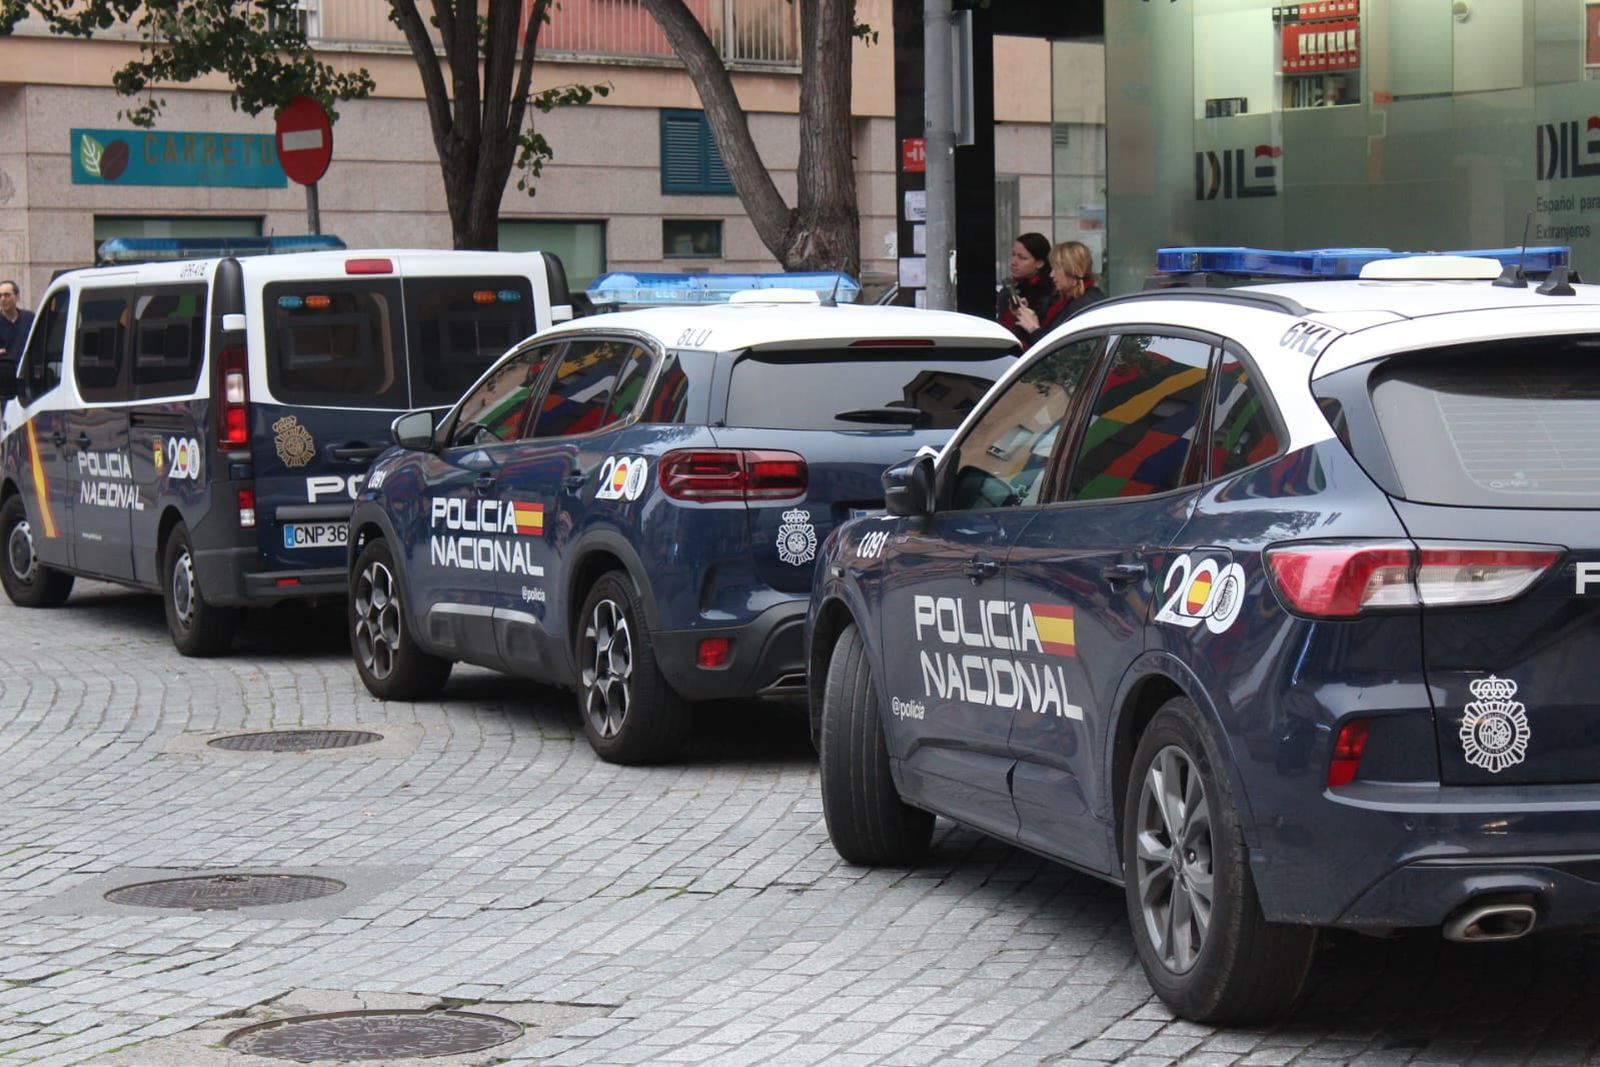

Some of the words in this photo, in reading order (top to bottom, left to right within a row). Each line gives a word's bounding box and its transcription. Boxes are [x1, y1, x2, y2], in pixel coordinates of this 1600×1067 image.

[1196, 145, 1281, 200] DILE
[1537, 195, 1575, 215] Español
[1537, 224, 1591, 242] Extranjeros
[78, 448, 132, 479] POLICÍA
[168, 436, 200, 480] 200
[595, 456, 648, 500] 200
[80, 480, 144, 510] NACIONAL
[431, 534, 544, 577] NACIONAL
[1154, 553, 1246, 634] 200
[914, 595, 1044, 654] POLICÍA
[920, 650, 1084, 721] NACIONAL
